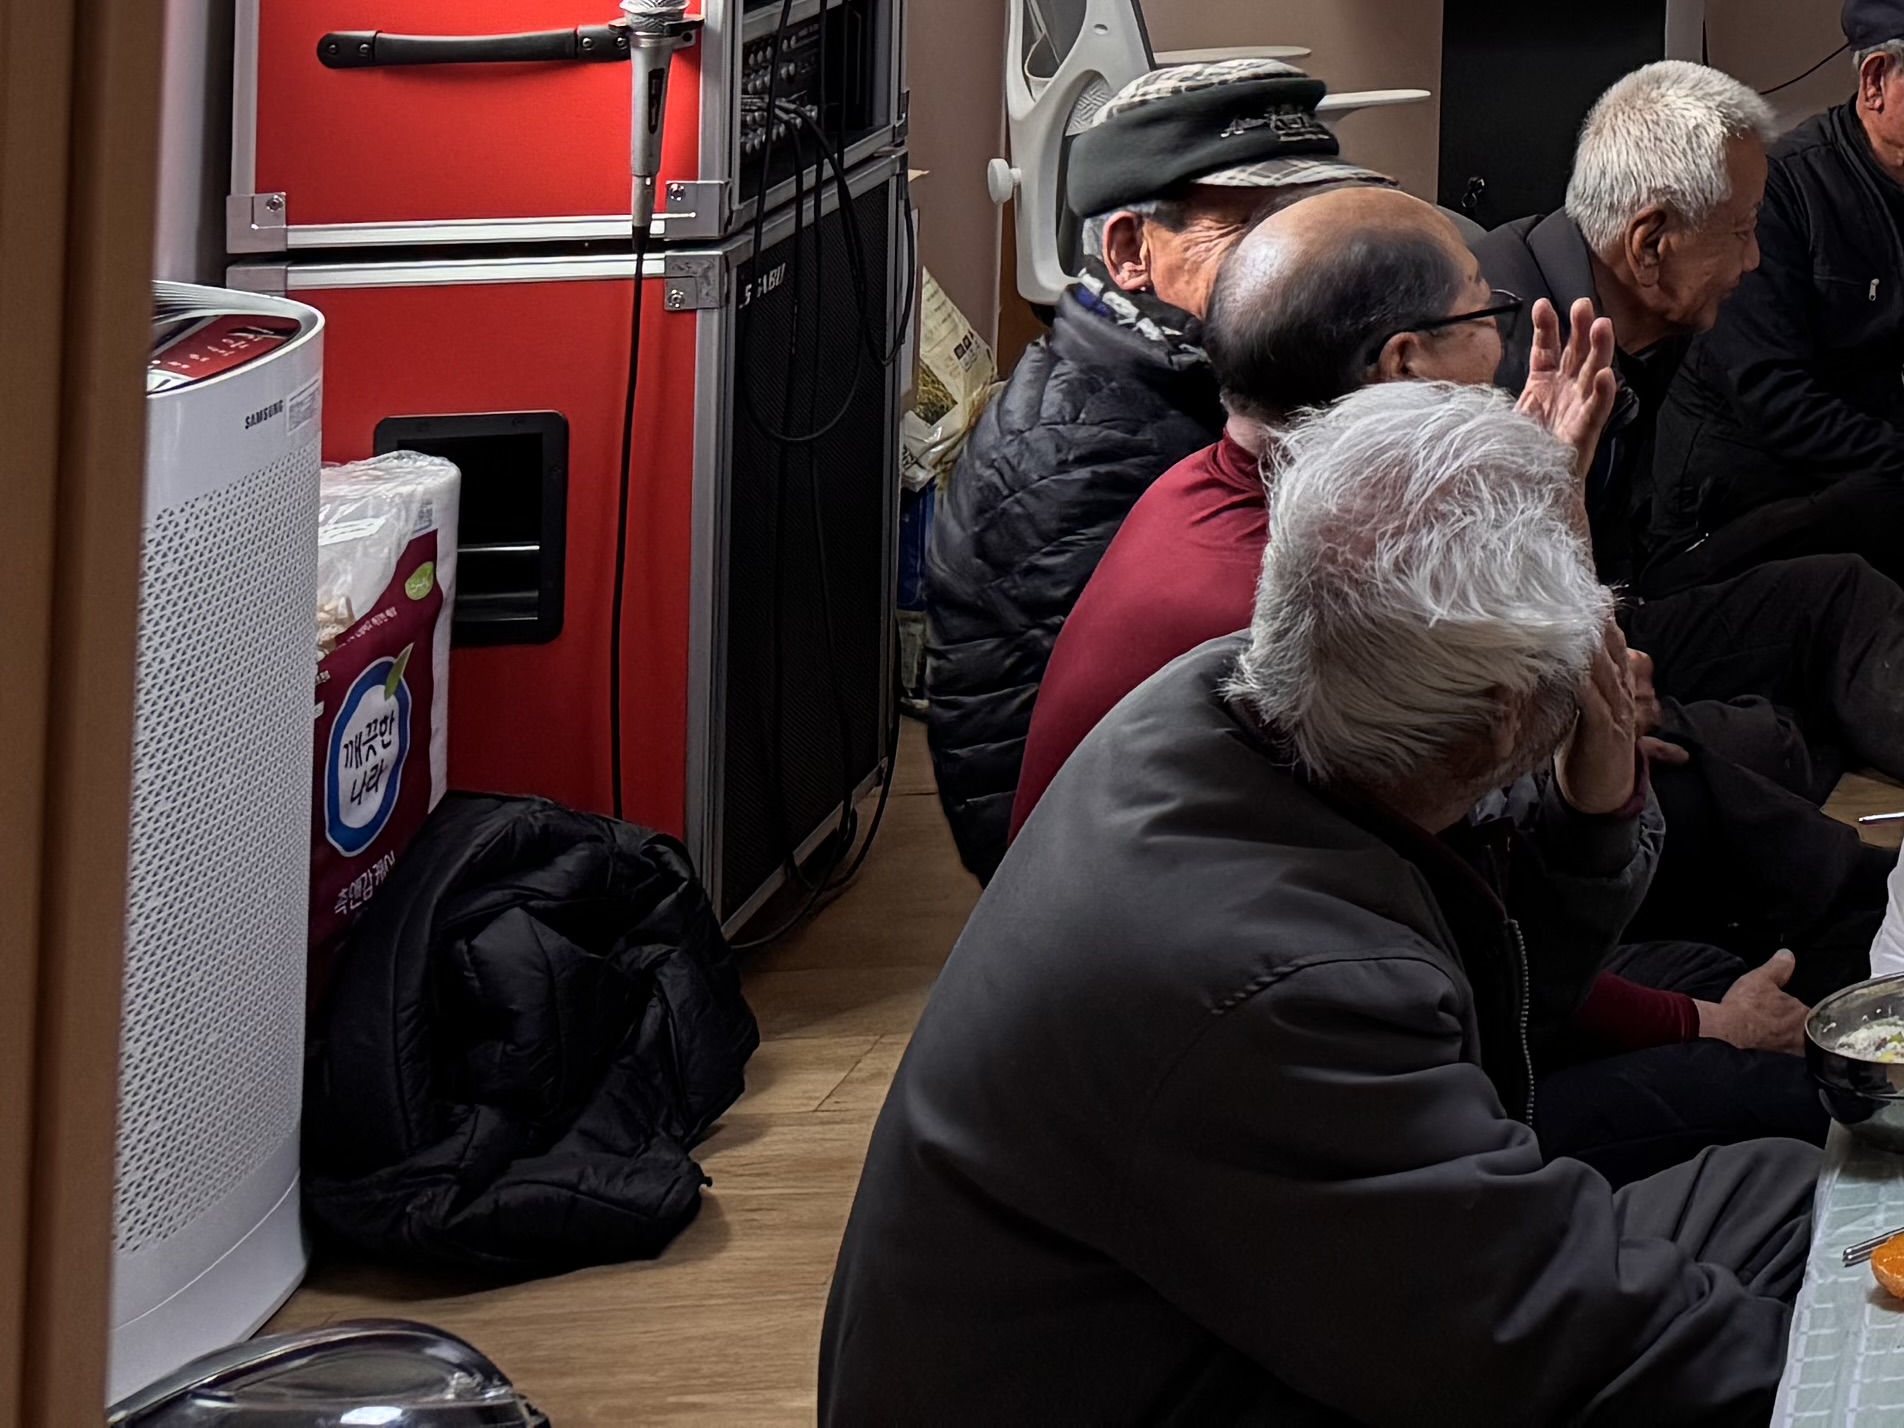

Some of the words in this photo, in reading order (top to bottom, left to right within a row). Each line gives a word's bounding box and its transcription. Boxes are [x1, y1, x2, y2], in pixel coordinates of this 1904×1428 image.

[245, 400, 283, 429] SAMSUNG
[343, 710, 395, 770] 깨끗한
[352, 758, 387, 805] 나라
